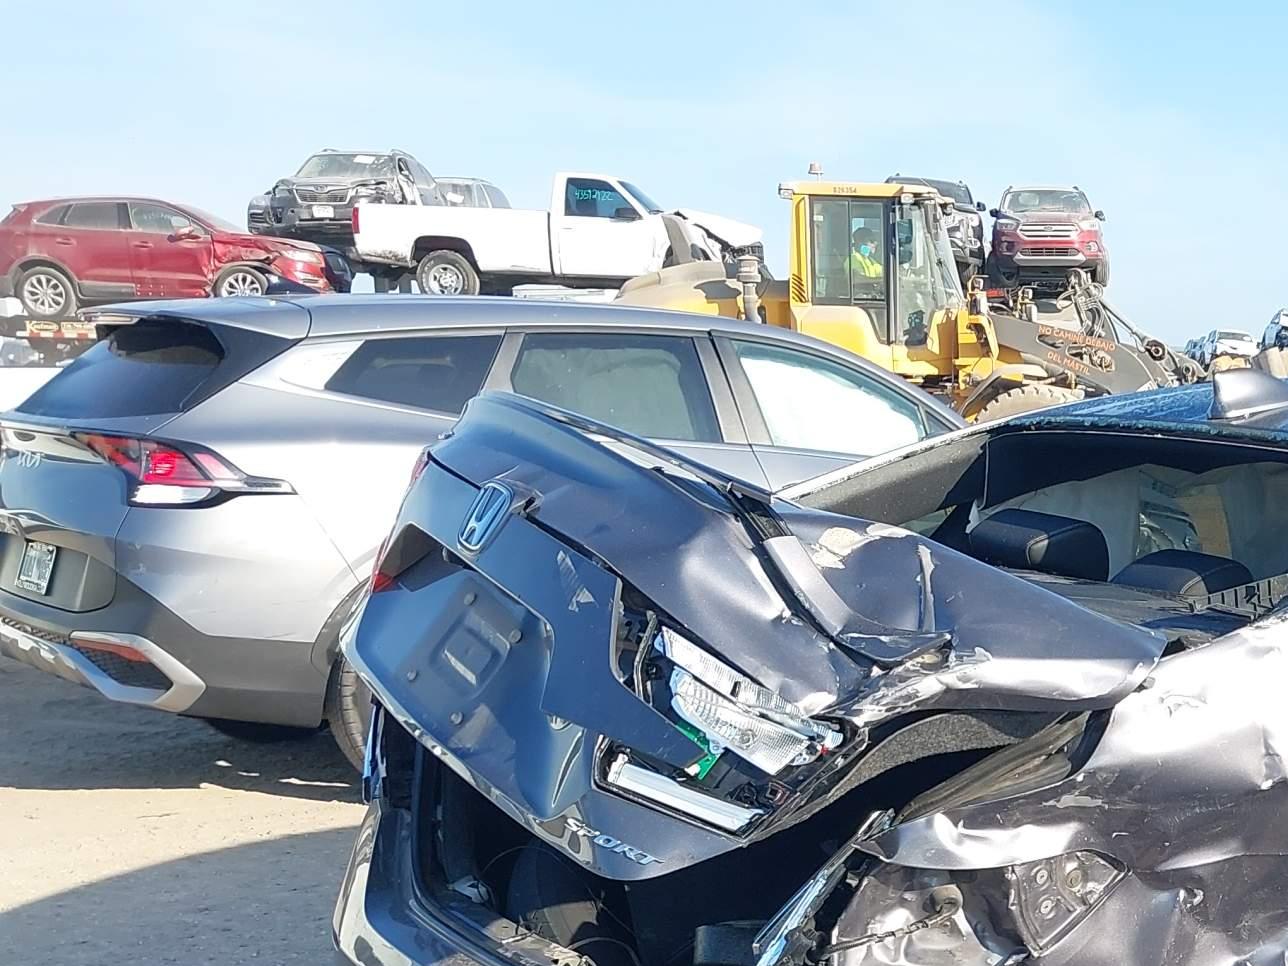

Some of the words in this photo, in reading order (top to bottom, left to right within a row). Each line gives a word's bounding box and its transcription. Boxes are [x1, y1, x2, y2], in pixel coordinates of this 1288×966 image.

[1038, 325, 1052, 335] NO
[1047, 351, 1063, 363] DEL
[564, 818, 665, 866] SPORT
